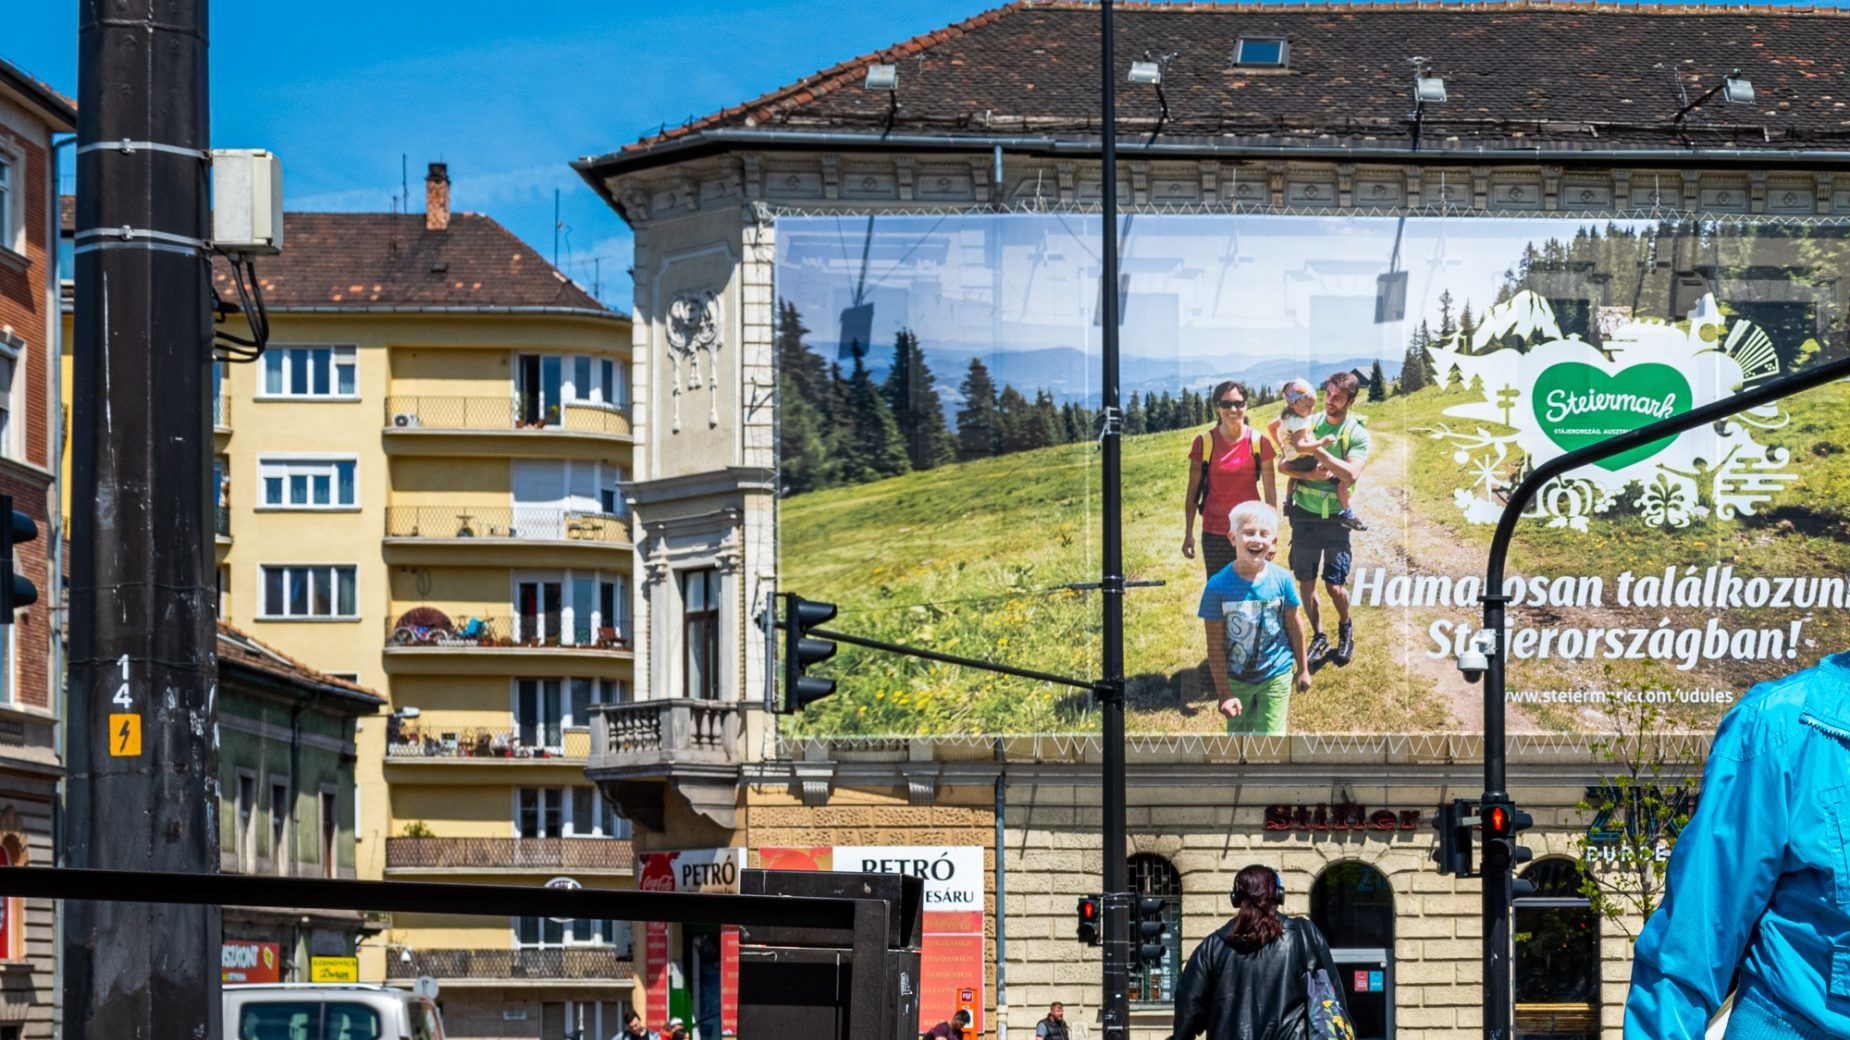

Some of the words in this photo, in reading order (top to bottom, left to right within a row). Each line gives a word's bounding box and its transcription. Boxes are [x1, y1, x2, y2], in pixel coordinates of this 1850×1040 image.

[1546, 388, 1677, 423] Steiermark
[682, 855, 736, 887] PETRÓ
[925, 886, 974, 903] ESÁRU
